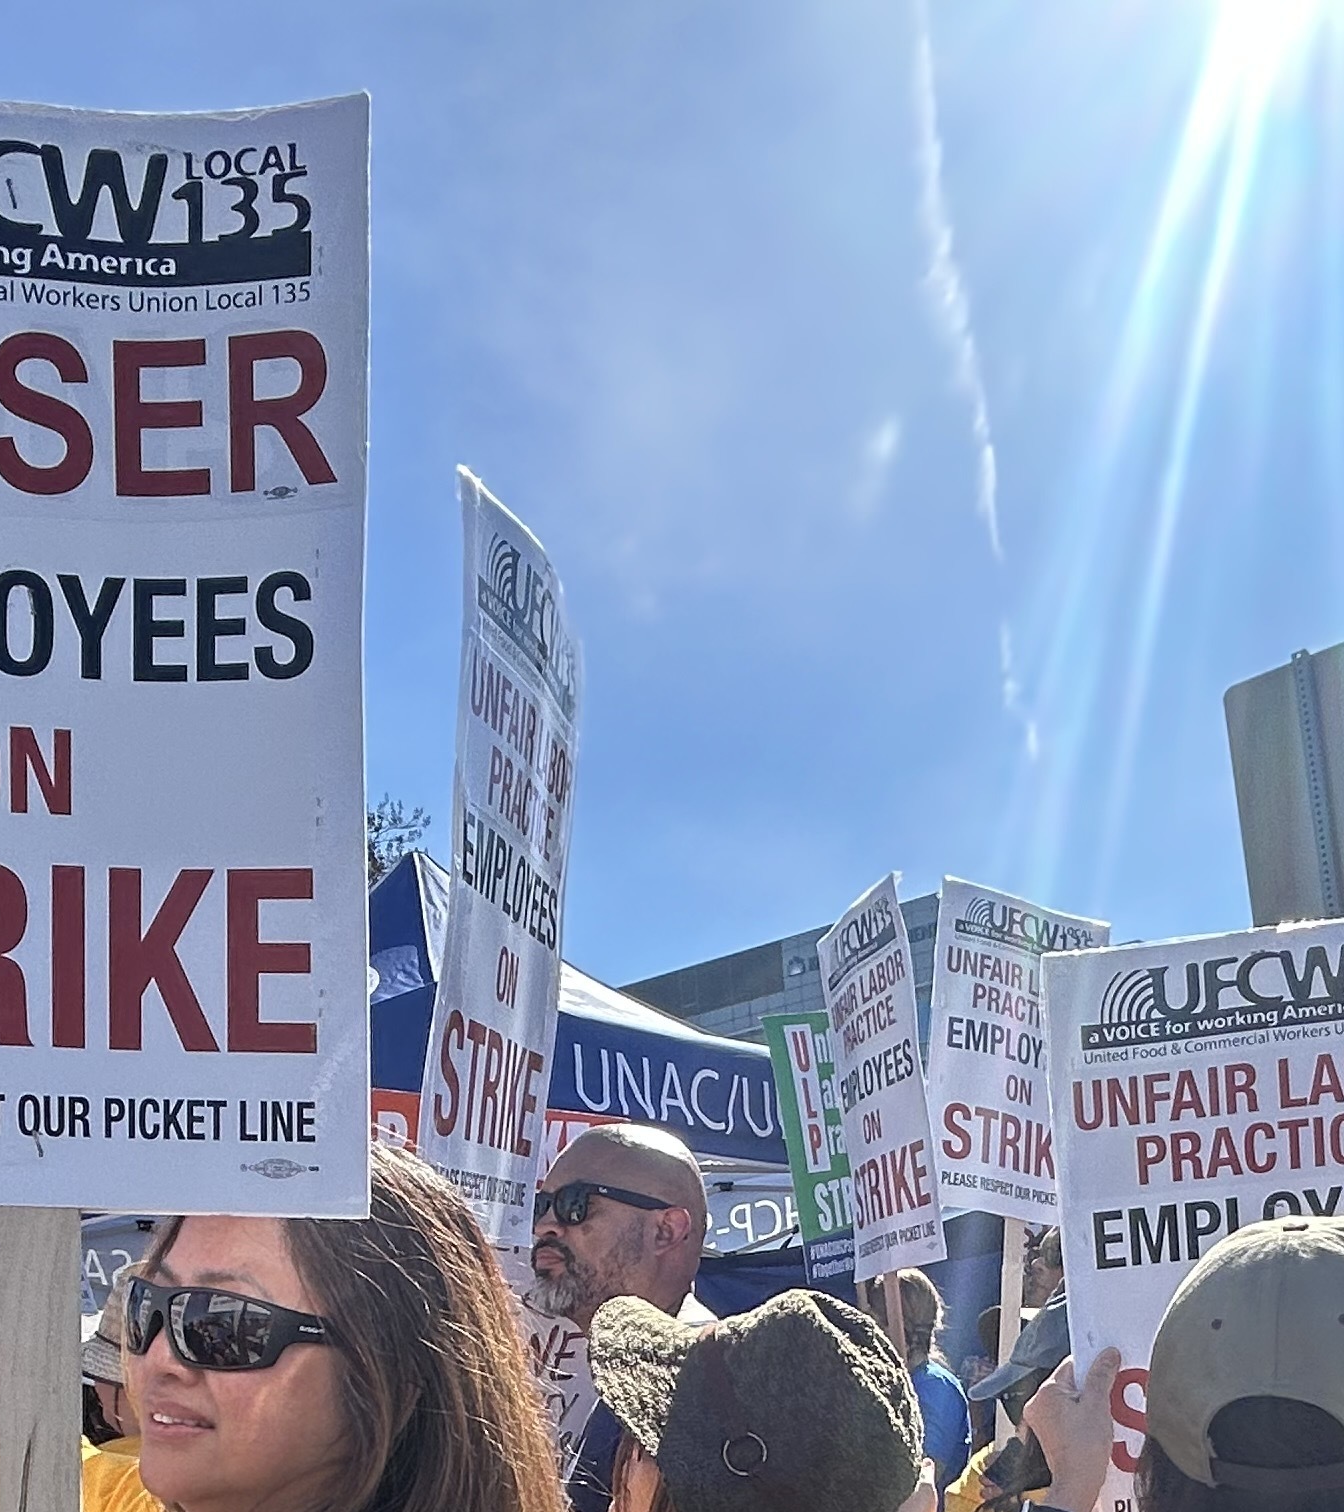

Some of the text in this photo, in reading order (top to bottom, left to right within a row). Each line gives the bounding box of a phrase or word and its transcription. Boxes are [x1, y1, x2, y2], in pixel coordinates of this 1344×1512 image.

[183, 143, 308, 181] LOCAL
[170, 170, 312, 244] 135
[41, 245, 177, 277] America
[21, 282, 122, 313] Workers
[127, 290, 199, 313] Union
[204, 284, 264, 310] Local
[270, 280, 311, 305] 135
[470, 642, 538, 766] UNFAIR
[488, 744, 555, 862] PRACTICE
[461, 811, 557, 952] EMPLOYEES
[989, 901, 1059, 950] UFCW
[496, 946, 520, 1009] ON
[861, 948, 906, 1005] LABOR
[947, 946, 1025, 989] UNFAIR
[972, 982, 1041, 1030] PRACTI
[1088, 1031, 1099, 1046] a
[1103, 1023, 1161, 1044] VOICE
[1165, 1018, 1192, 1036] for
[1197, 1007, 1279, 1031] working
[947, 1017, 1043, 1071] EMPLOY
[1083, 1048, 1130, 1066] United
[1131, 1043, 1168, 1060] Food
[1171, 1040, 1182, 1057] &
[1184, 1030, 1271, 1054] Commercial
[1273, 1023, 1332, 1043] Workers
[433, 1009, 544, 1157] STRIKE
[573, 1042, 775, 1138] UNAC/U
[841, 1038, 914, 1115] EMPLOYEES
[1006, 1073, 1033, 1106] ON
[1072, 1060, 1261, 1132] UNFAIR
[17, 1092, 91, 1140] OUR
[102, 1097, 227, 1142] PICKET
[239, 1100, 317, 1144] LINE
[862, 1108, 882, 1145] ON
[941, 1102, 1056, 1180] STRIK
[855, 1139, 932, 1230] STRIKE
[941, 1171, 979, 1189] PLEASE
